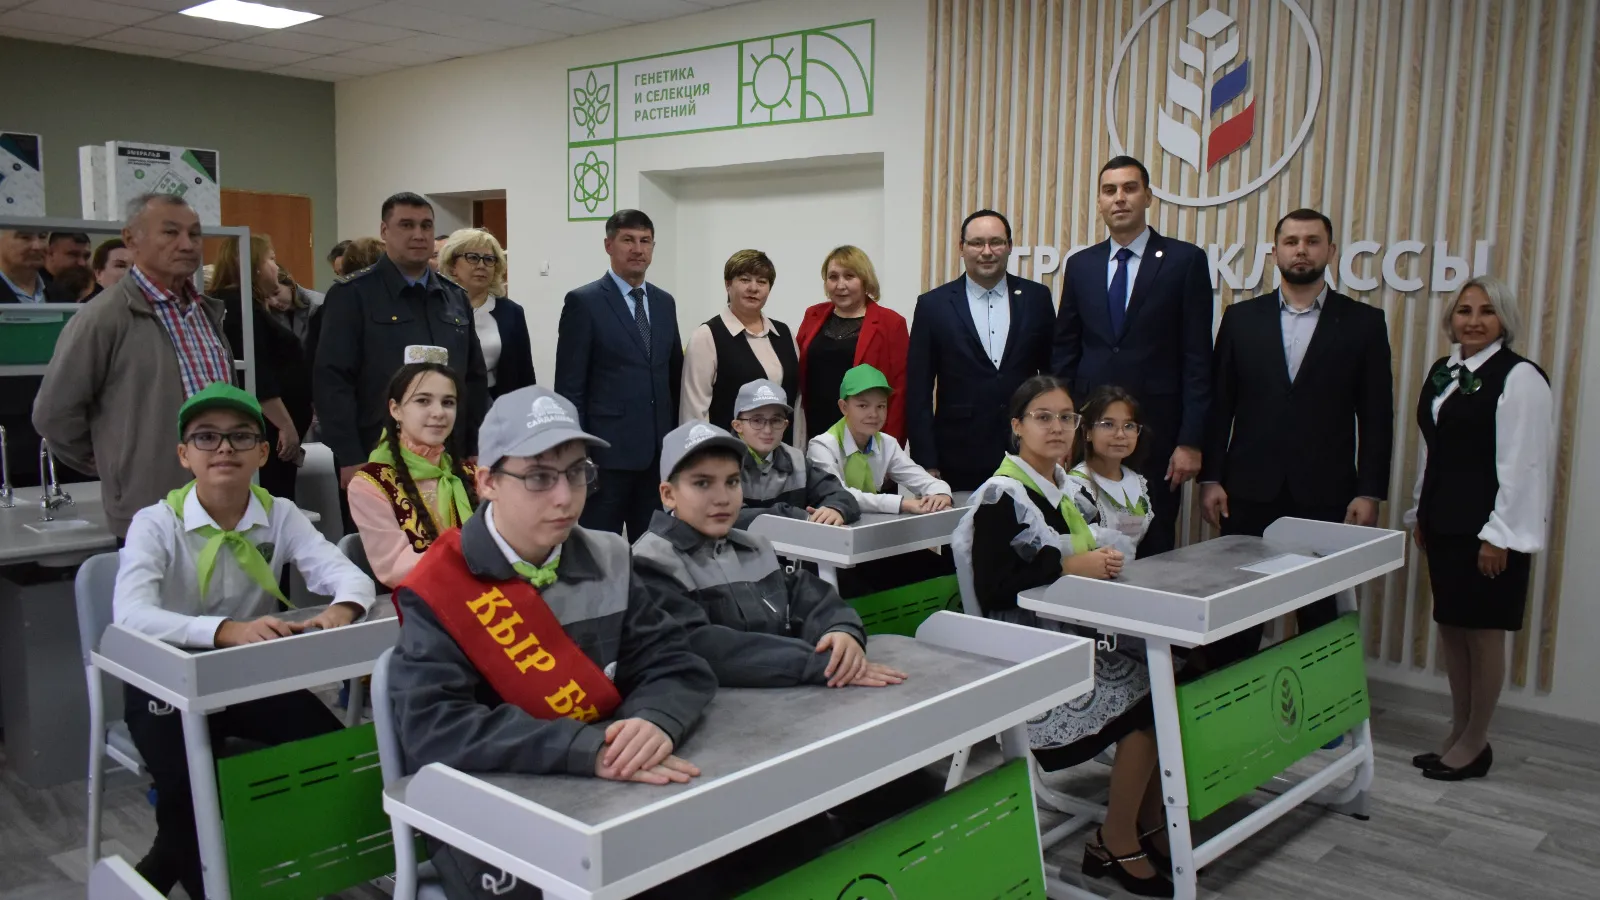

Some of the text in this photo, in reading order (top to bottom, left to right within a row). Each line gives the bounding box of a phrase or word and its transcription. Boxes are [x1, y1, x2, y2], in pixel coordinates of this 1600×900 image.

[634, 66, 695, 87] ГЕНЕТИКА
[634, 82, 710, 105] И СЕЛЕКЦИЯ
[634, 99, 696, 122] РАСТЕНИЙ
[466, 586, 556, 674] КЫР
